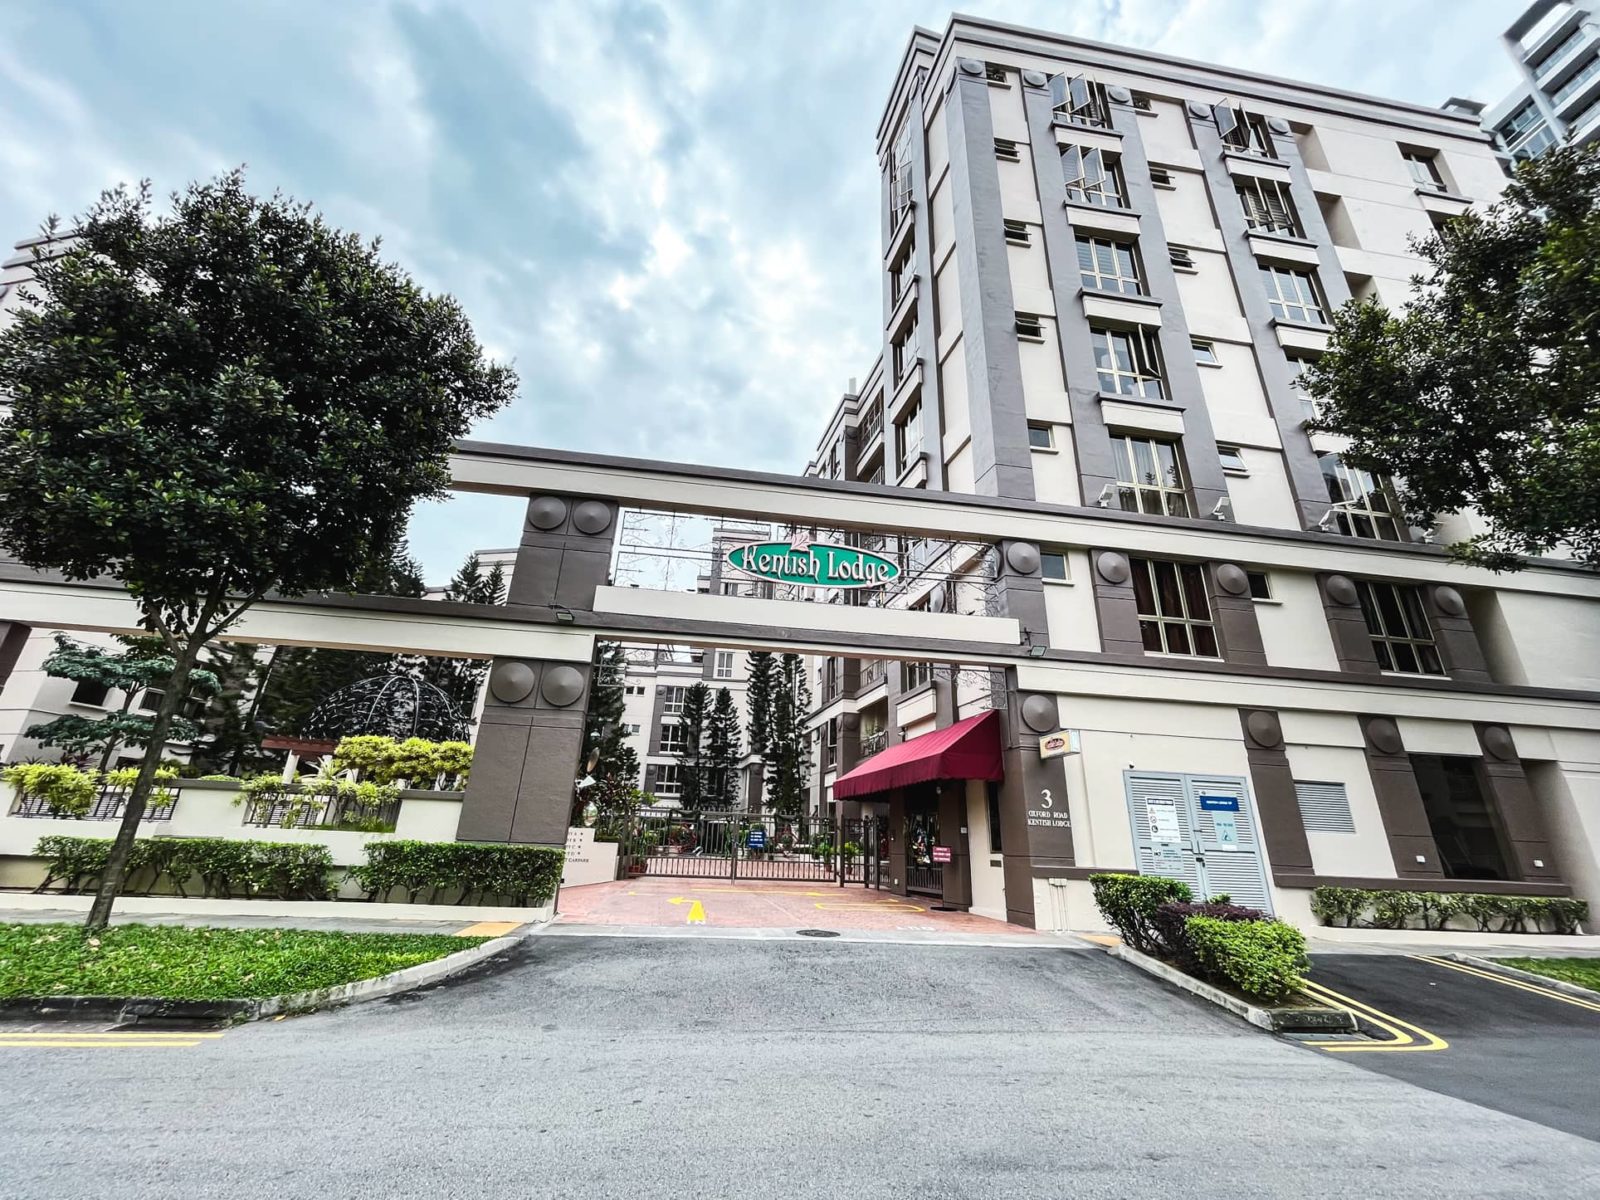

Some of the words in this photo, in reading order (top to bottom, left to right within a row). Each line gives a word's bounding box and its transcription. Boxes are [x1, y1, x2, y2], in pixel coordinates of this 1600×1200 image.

[741, 545, 820, 583] Kentish
[827, 551, 889, 585] Lodge
[1041, 789, 1052, 809] 3
[1027, 818, 1052, 826] KENTISH
[1053, 811, 1068, 819] ROAD
